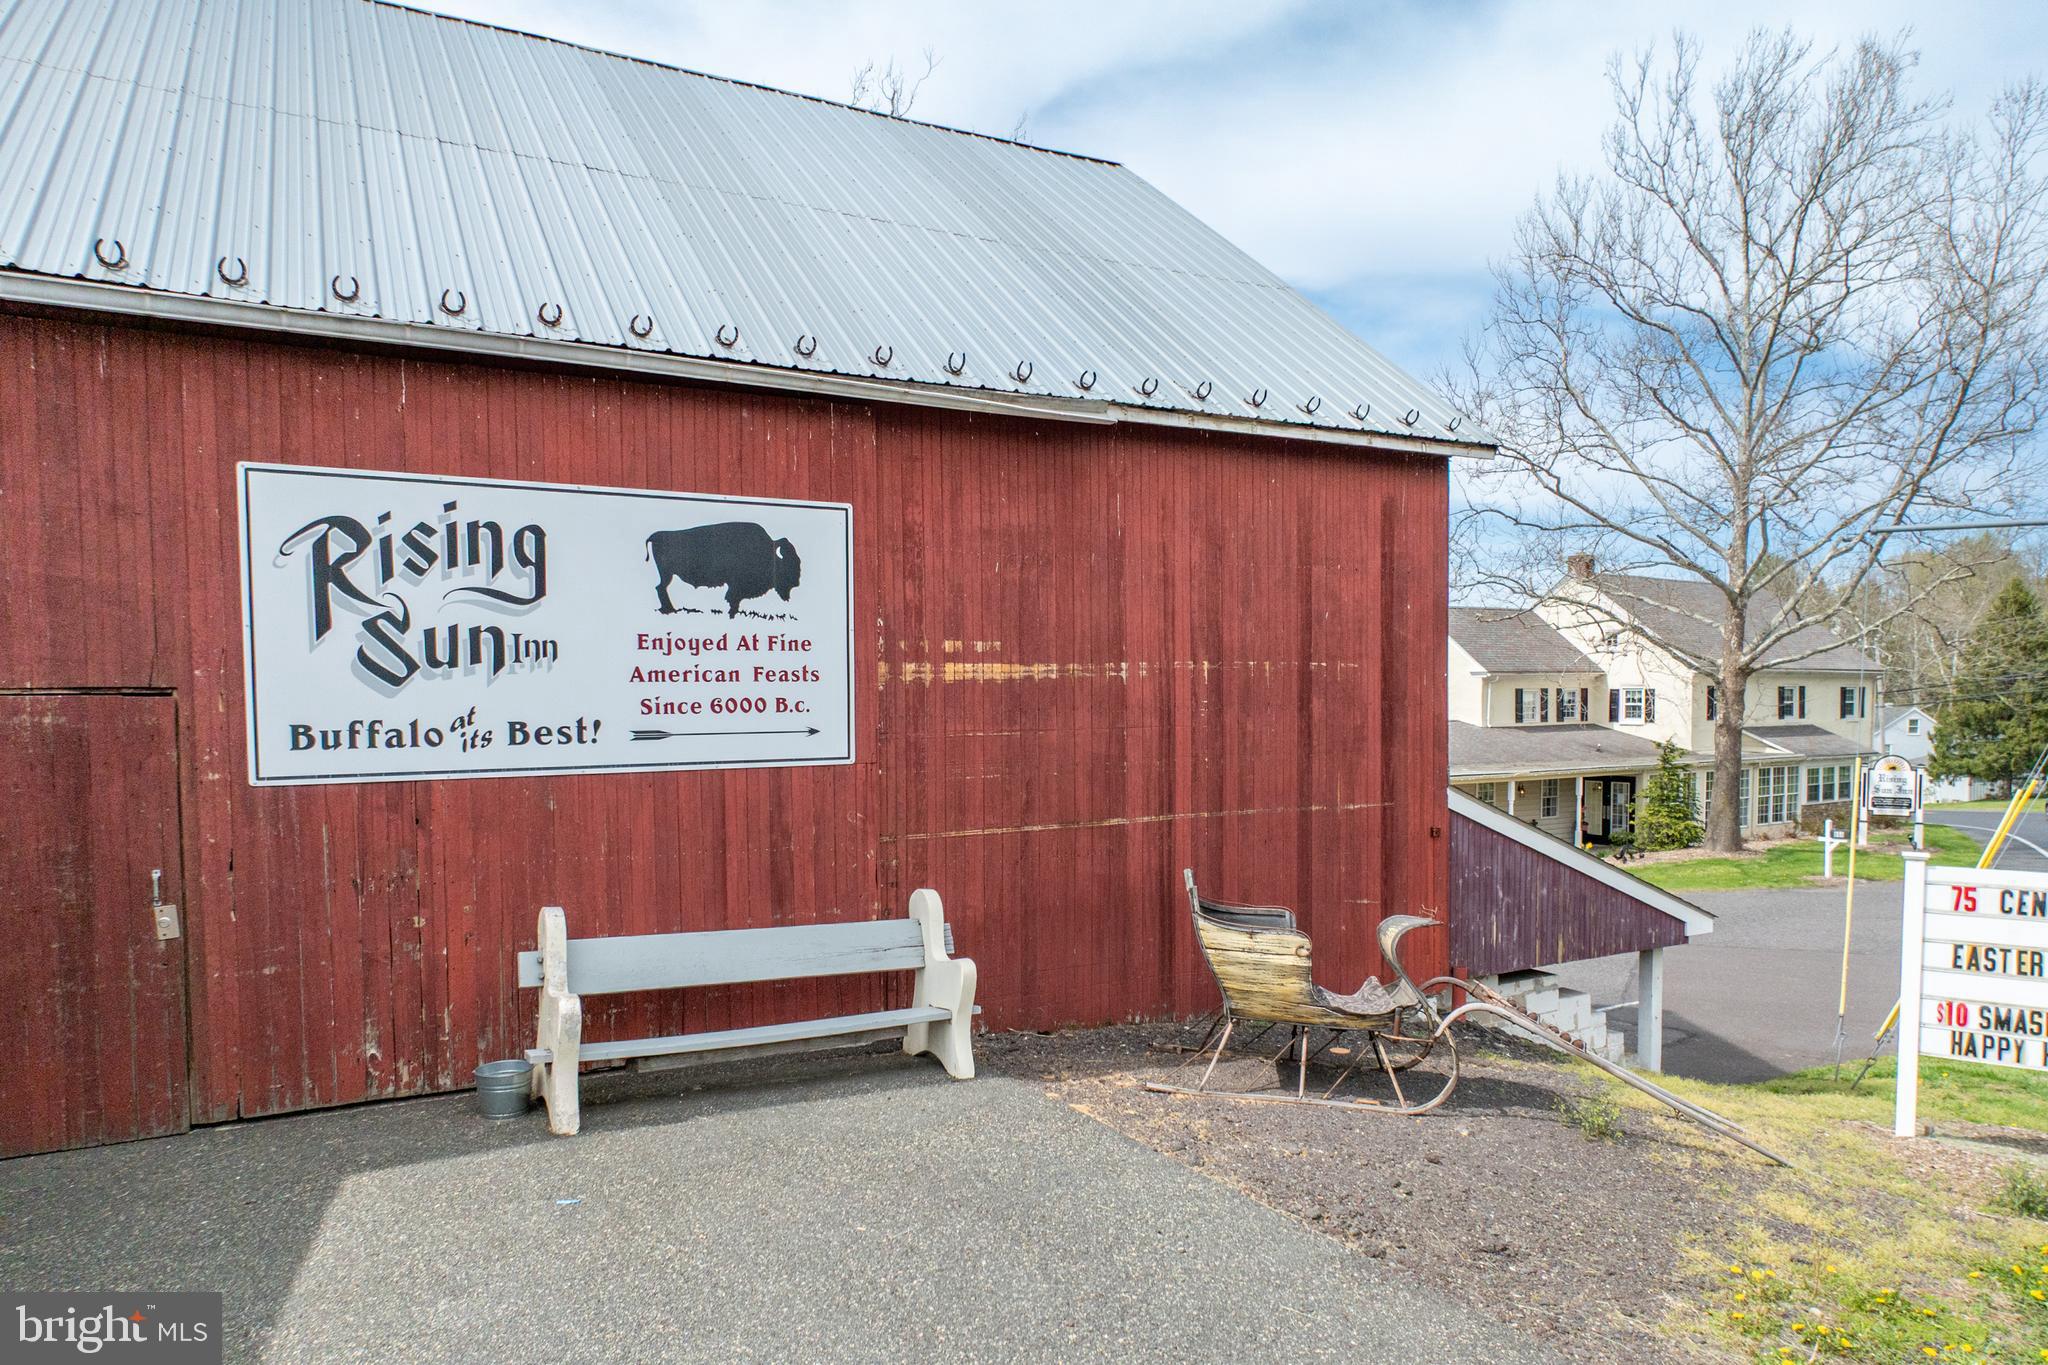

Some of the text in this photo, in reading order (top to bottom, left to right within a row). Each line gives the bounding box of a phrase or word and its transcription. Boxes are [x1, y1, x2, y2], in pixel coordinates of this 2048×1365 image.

[279, 500, 547, 642] Rising
[356, 592, 560, 688] Sun Inn
[636, 632, 813, 656] Enjoyed At Fine
[629, 664, 821, 683] American Feasts
[640, 696, 703, 715] Since
[710, 697, 768, 714] 6000
[289, 705, 602, 753] Buffalo at its Best!
[1951, 885, 2048, 917] 75 CEN
[1951, 943, 2045, 977] EASTER
[1936, 1000, 2048, 1037] $10 SMAS
[1949, 1030, 2025, 1064] HAPPY
